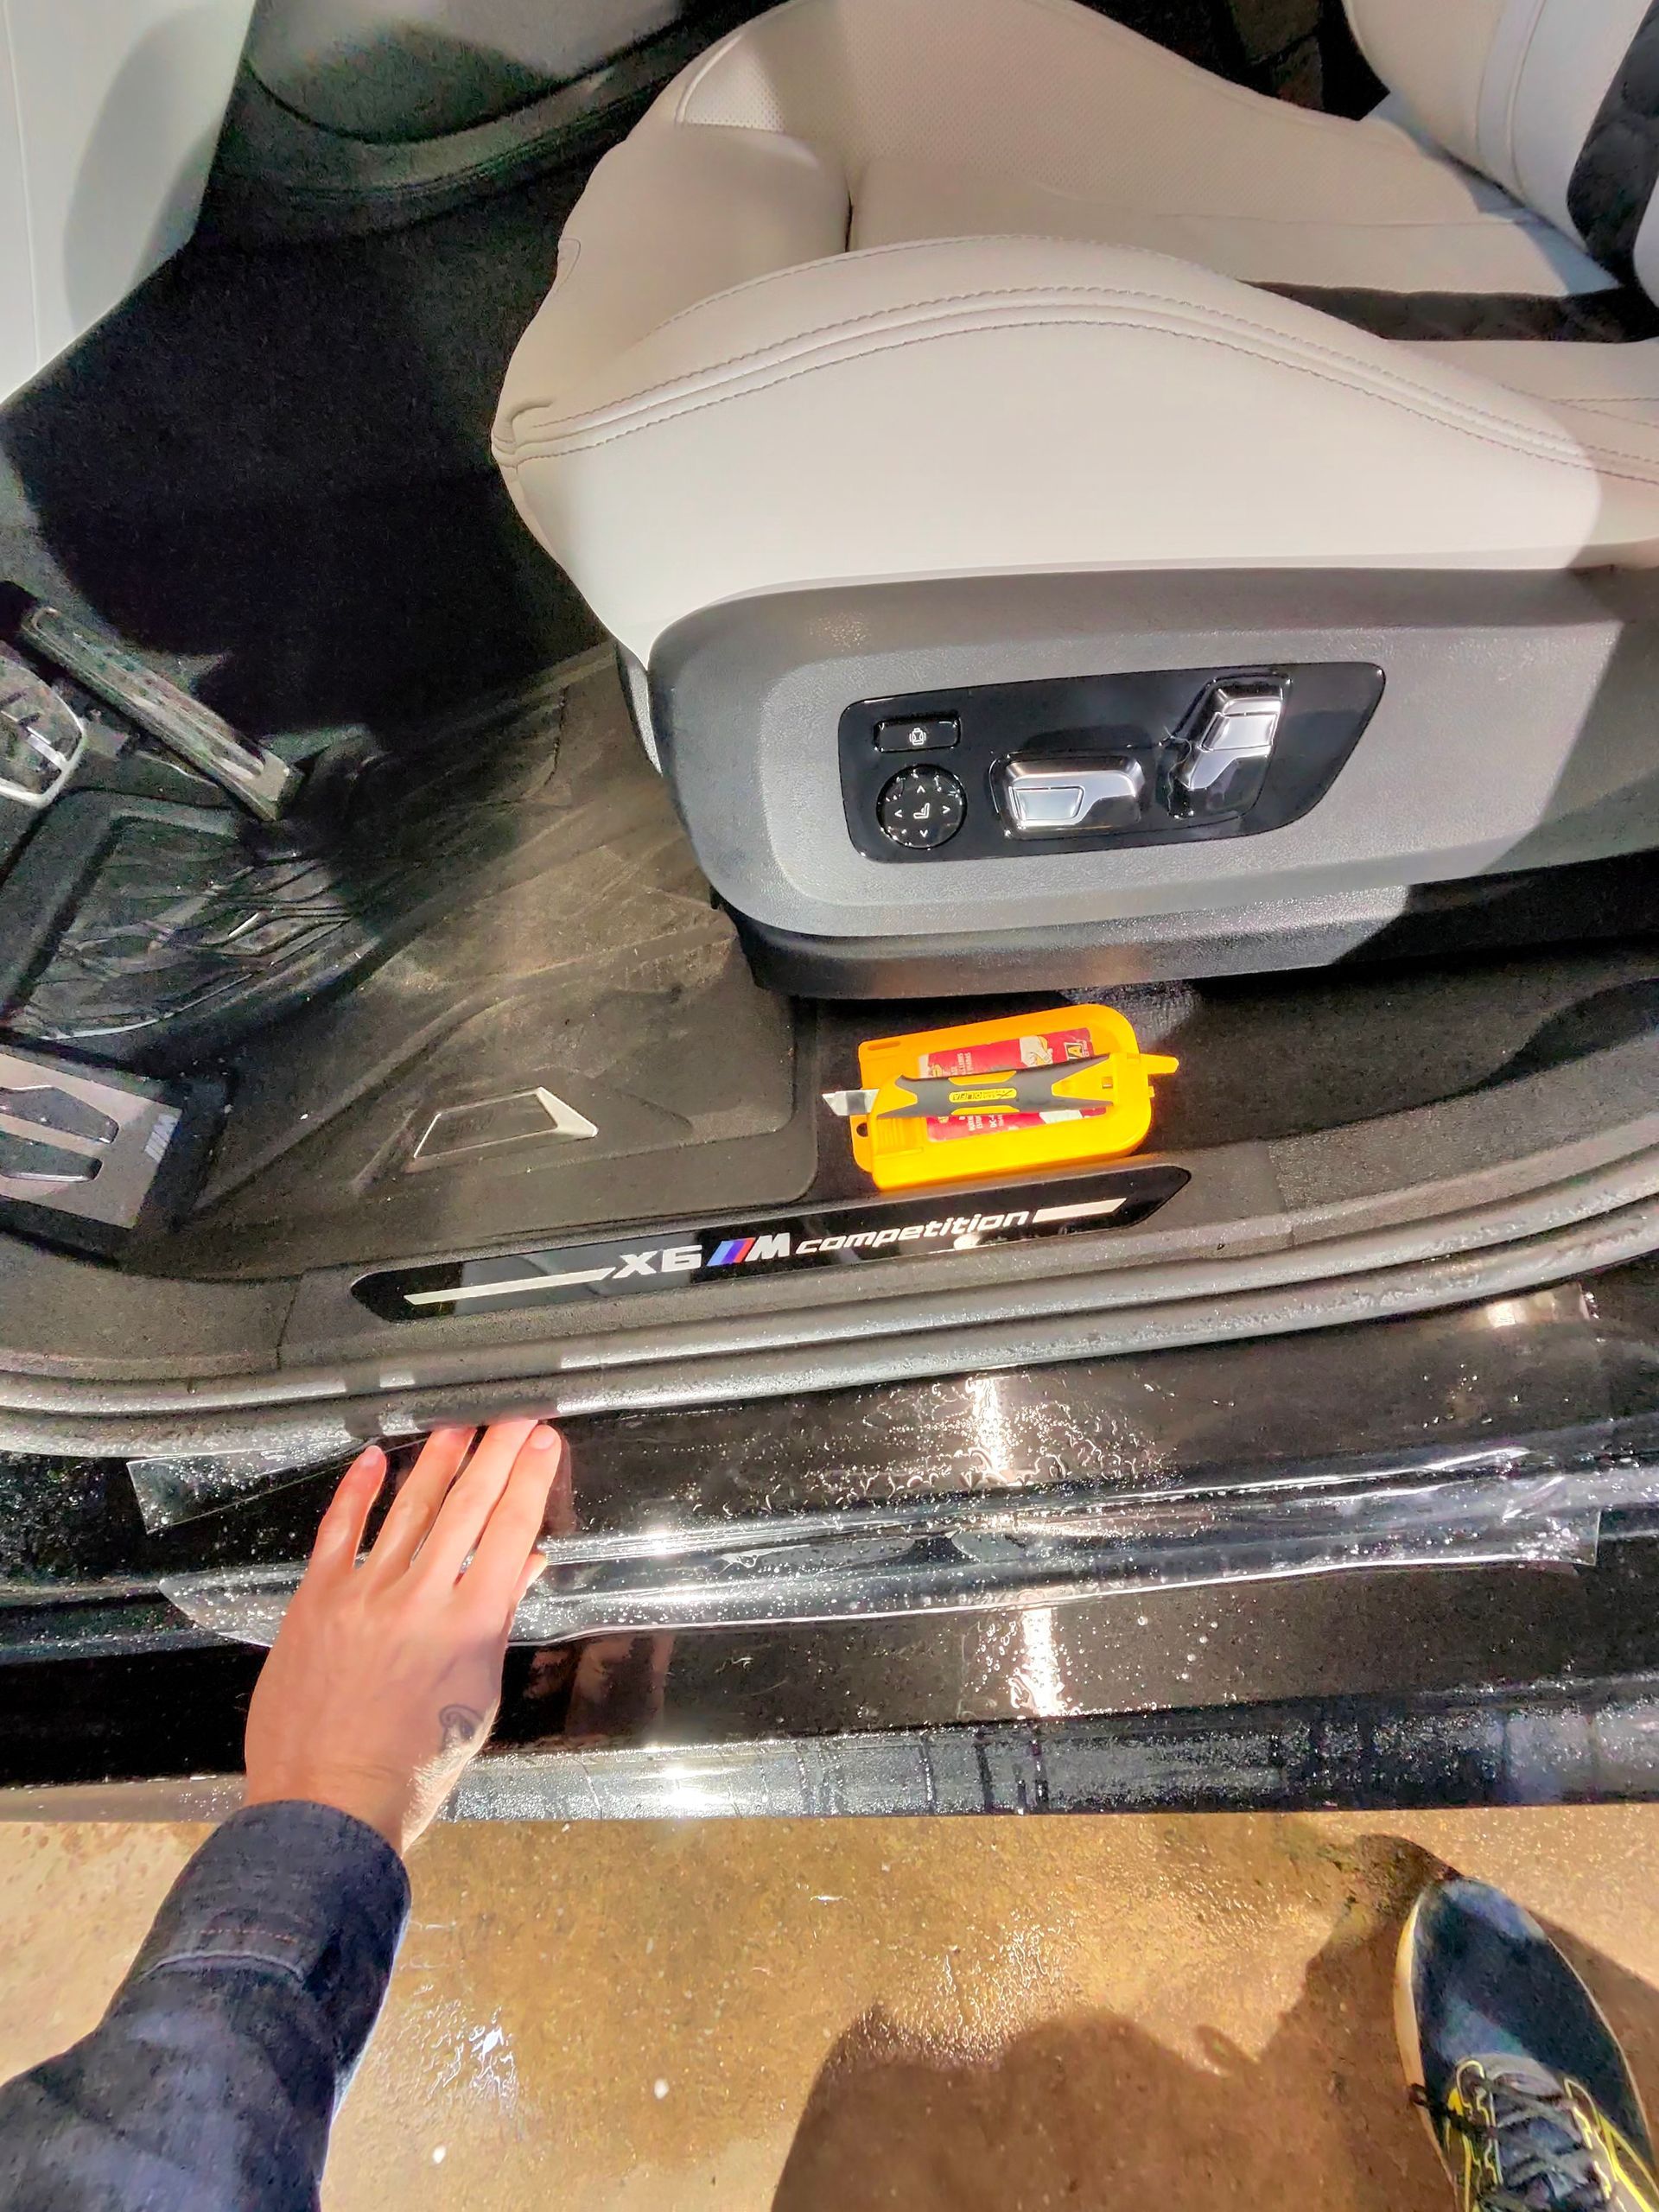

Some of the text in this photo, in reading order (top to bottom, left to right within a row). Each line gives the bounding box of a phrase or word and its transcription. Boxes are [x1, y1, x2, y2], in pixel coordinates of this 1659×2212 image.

[612, 1211, 1027, 1279] X6 M competition
